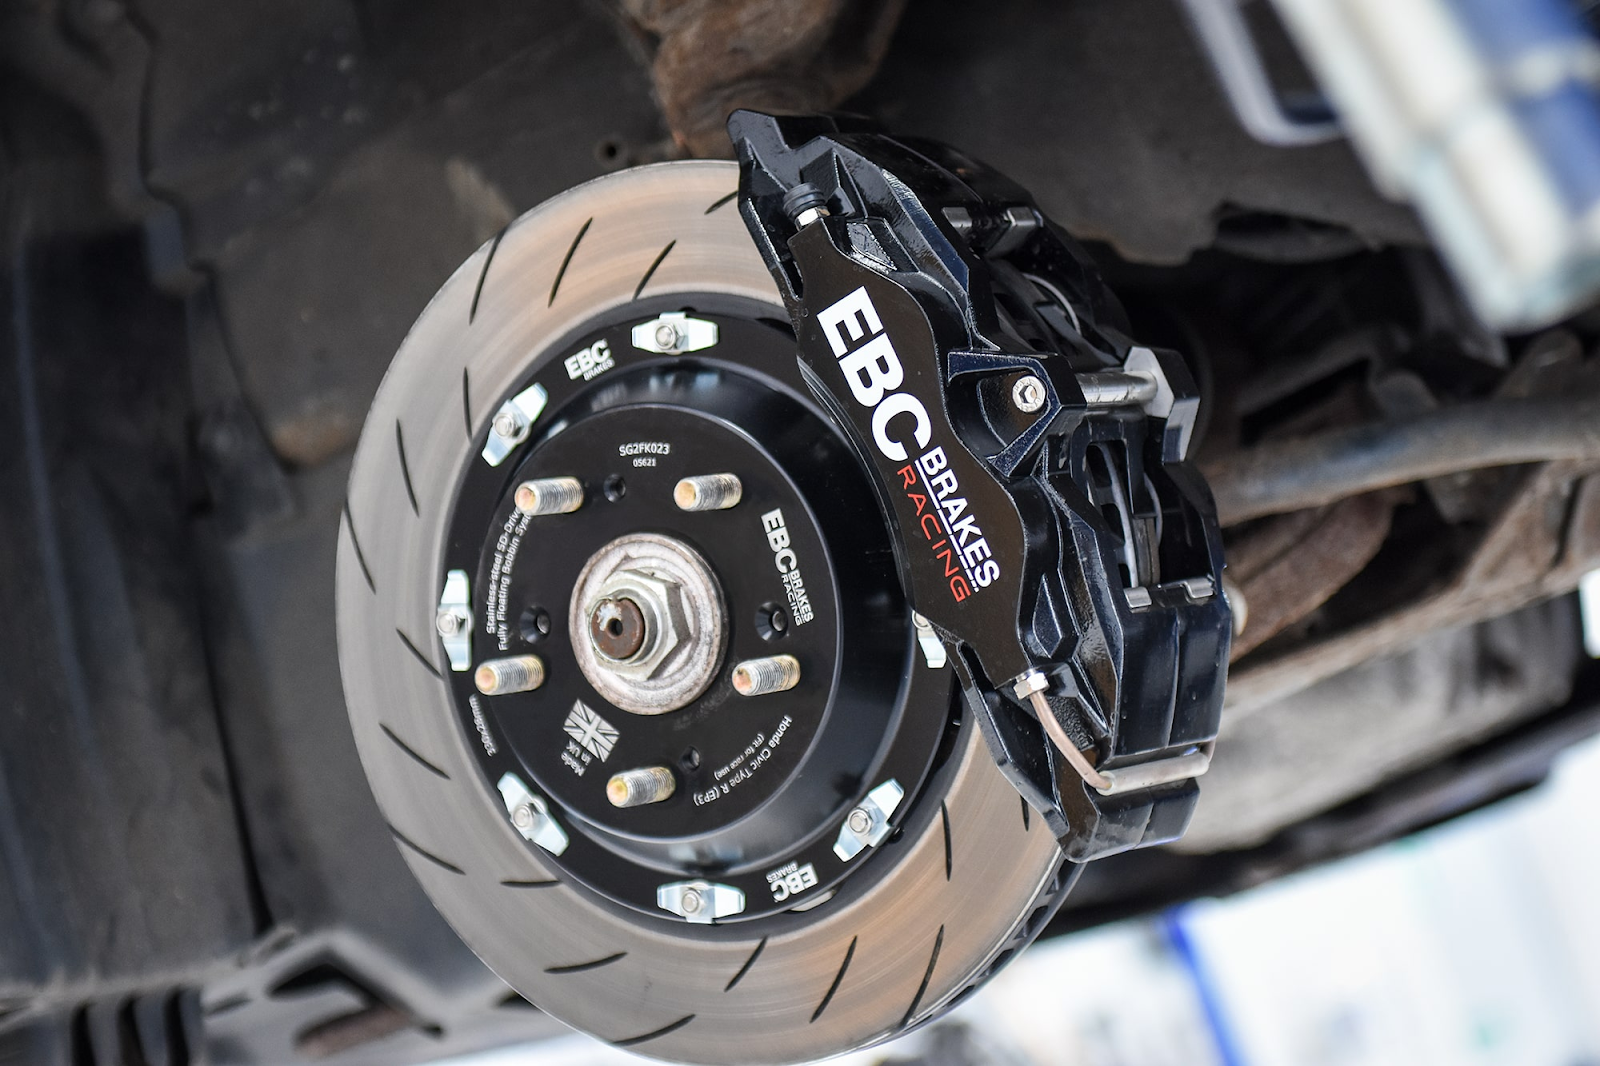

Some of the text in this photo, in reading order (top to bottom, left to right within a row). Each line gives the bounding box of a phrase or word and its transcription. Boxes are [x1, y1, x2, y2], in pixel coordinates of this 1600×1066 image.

[563, 338, 612, 380] EBC
[583, 357, 616, 381] BRAKES
[816, 285, 932, 462] EBC
[618, 441, 671, 457] SG2FK023
[632, 458, 657, 468] 05621
[897, 464, 971, 602] RACING
[919, 446, 1000, 589] BRAKES
[501, 537, 520, 574] Bobbin
[761, 507, 798, 574] EBC
[486, 550, 503, 635] Stainless-steel
[496, 574, 511, 621] Floating
[781, 574, 804, 627] RACING
[788, 568, 815, 623] BRAKES
[497, 620, 509, 651] Fully
[560, 752, 587, 777] Made
[565, 740, 592, 766] in UK
[693, 714, 793, 806] Honda Civic Type R (EP3)
[714, 733, 765, 781] (Fit for race use)
[765, 860, 799, 883] BRAKES
[770, 862, 819, 902] EBC
